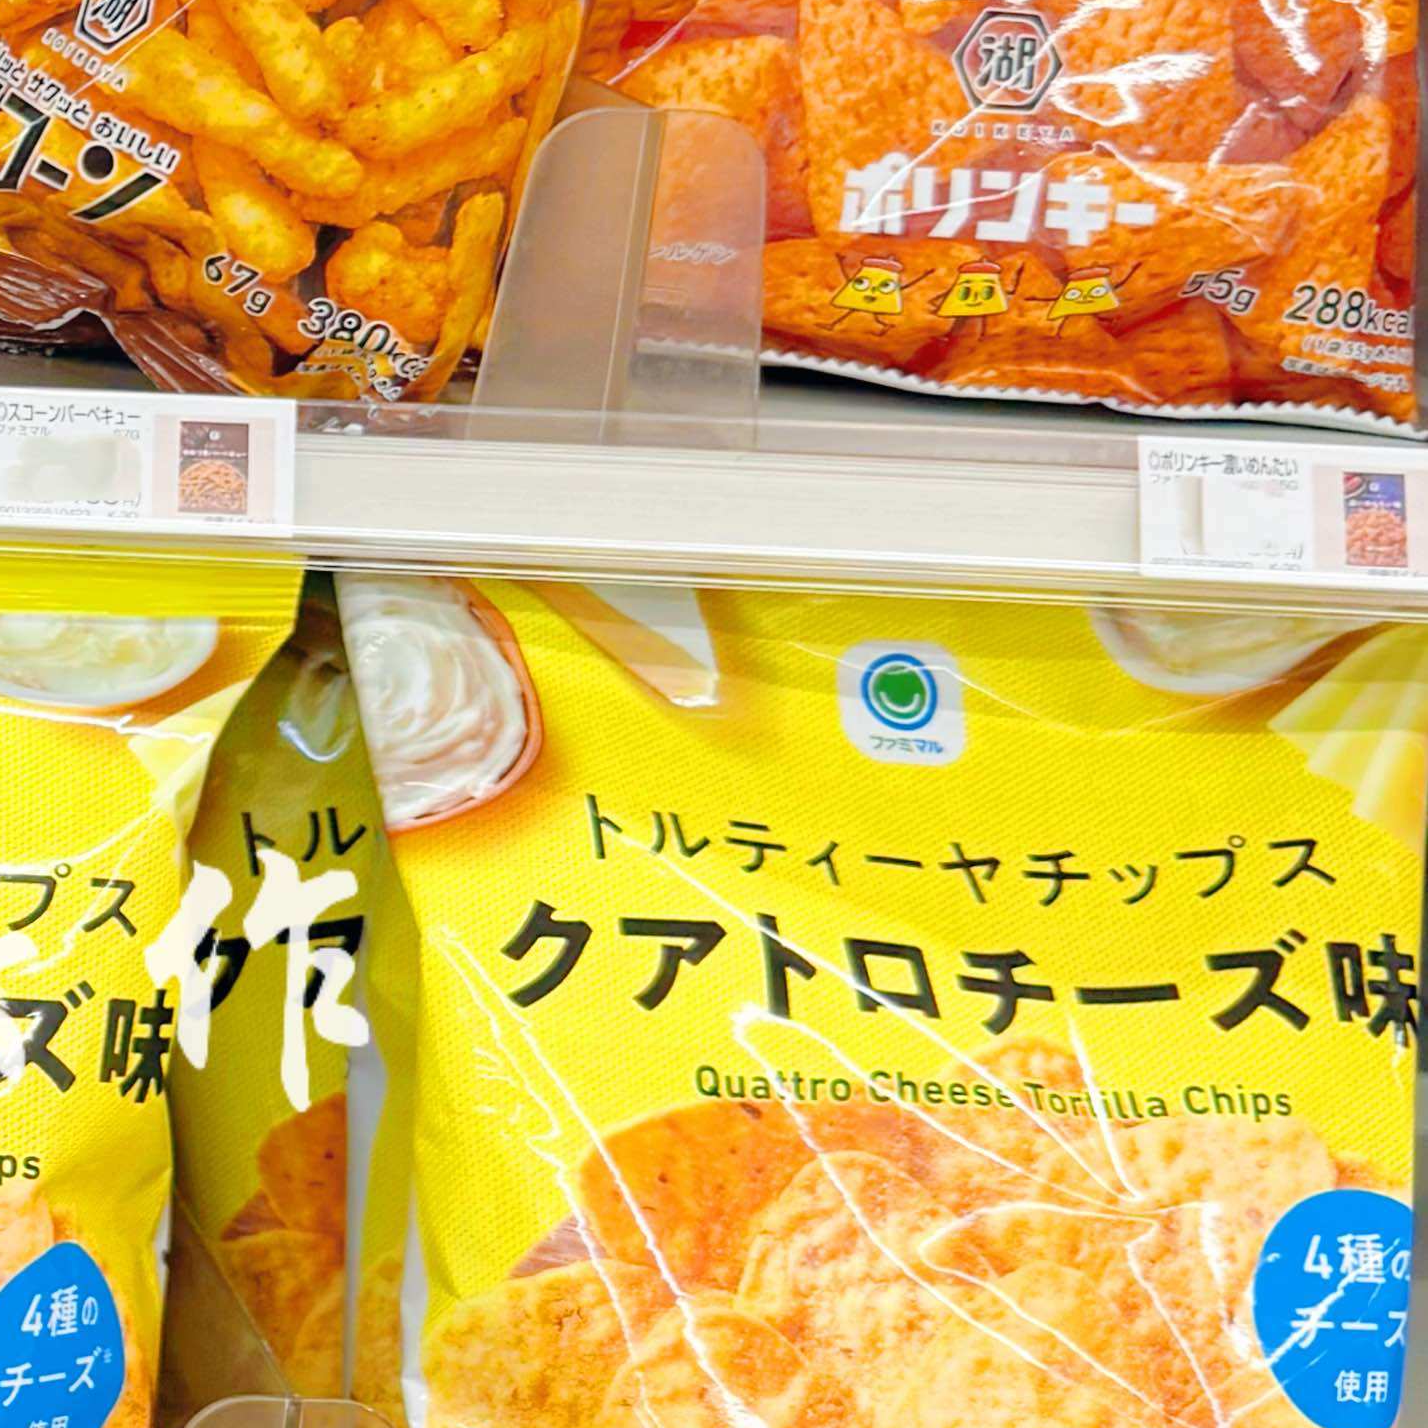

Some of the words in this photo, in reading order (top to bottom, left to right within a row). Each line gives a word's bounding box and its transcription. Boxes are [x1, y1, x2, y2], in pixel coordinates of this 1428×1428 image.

[839, 151, 1157, 248] ポリンキー
[204, 254, 273, 317] 67g
[584, 791, 1339, 909] トルティーヤチップス
[500, 900, 1424, 1051] クアトロチーズ味
[694, 1064, 853, 1106] Quattro
[867, 1070, 1015, 1111] Cheese
[1021, 1080, 1170, 1122] Tortilla
[1181, 1083, 1294, 1123] Chips
[21, 1284, 99, 1339] 4種の
[1333, 1370, 1390, 1404] 使用
